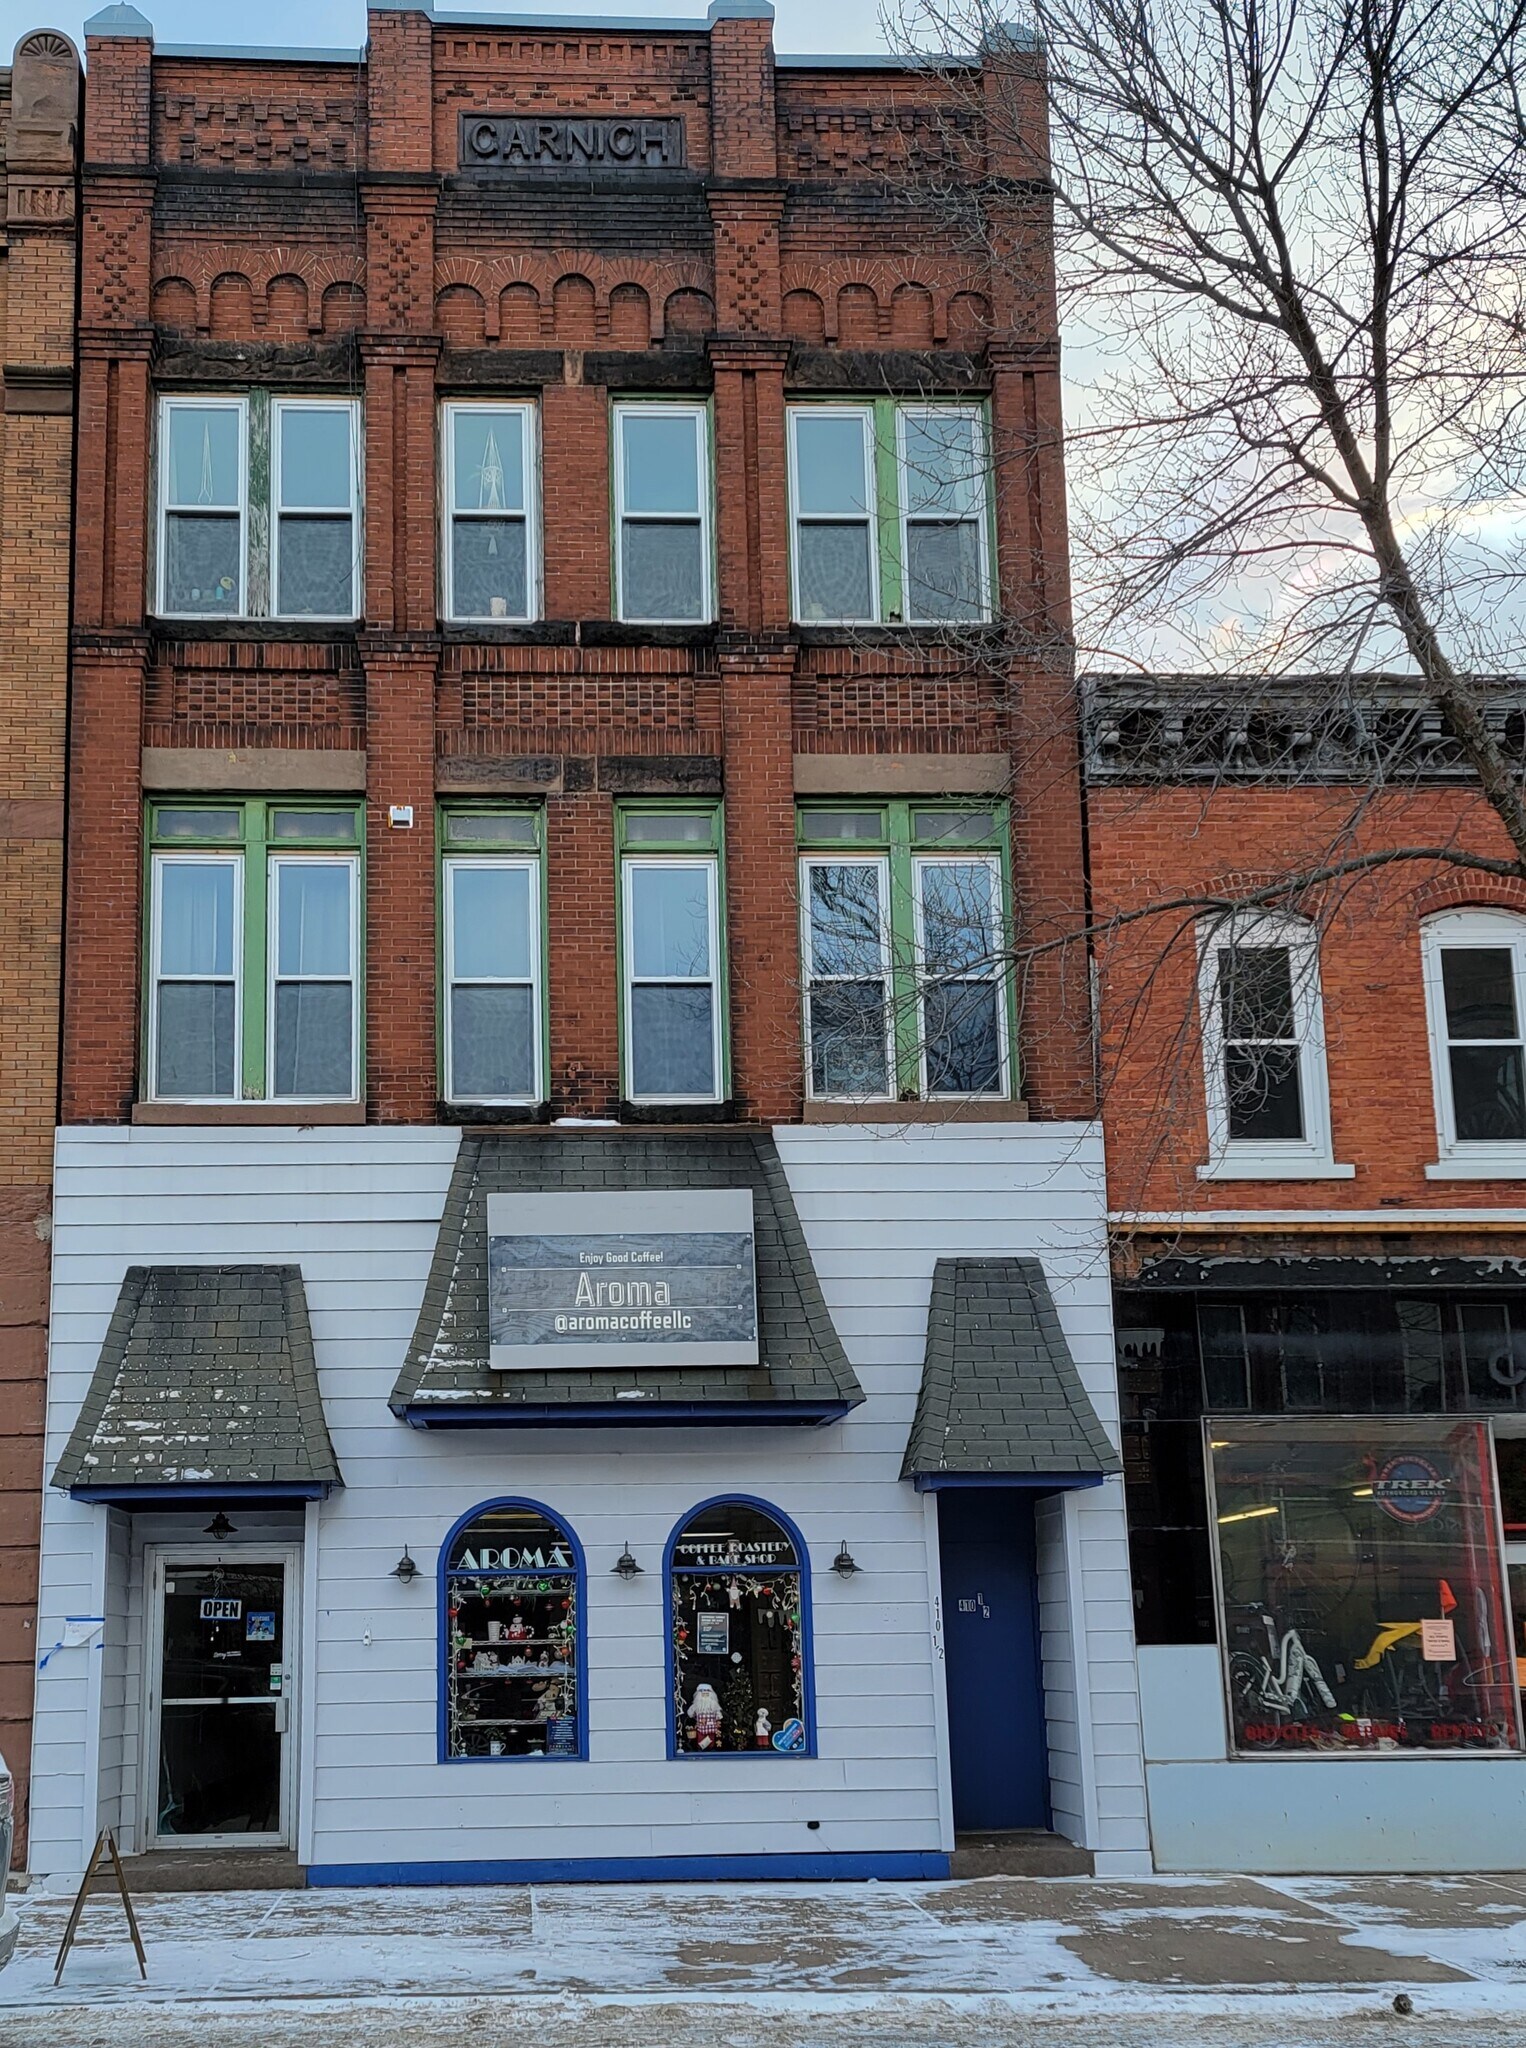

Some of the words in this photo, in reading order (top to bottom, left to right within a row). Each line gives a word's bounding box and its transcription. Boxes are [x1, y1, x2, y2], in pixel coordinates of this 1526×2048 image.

[470, 121, 669, 160] CARNICH
[580, 1252, 603, 1265] Enjoy
[606, 1252, 628, 1263] Good
[631, 1252, 664, 1263] Coffee!
[574, 1272, 671, 1307] Aroma
[554, 1310, 692, 1333] @aromacoffeellc
[1373, 1479, 1449, 1489] TREK
[680, 1543, 725, 1554] COFFEE
[729, 1542, 791, 1553] ROASTERY
[457, 1546, 570, 1570] AROMA
[696, 1556, 705, 1565] &
[709, 1554, 740, 1565] BAKE
[744, 1553, 777, 1564] SHOP
[204, 1601, 239, 1617] OPEN
[960, 1600, 976, 1611] 410
